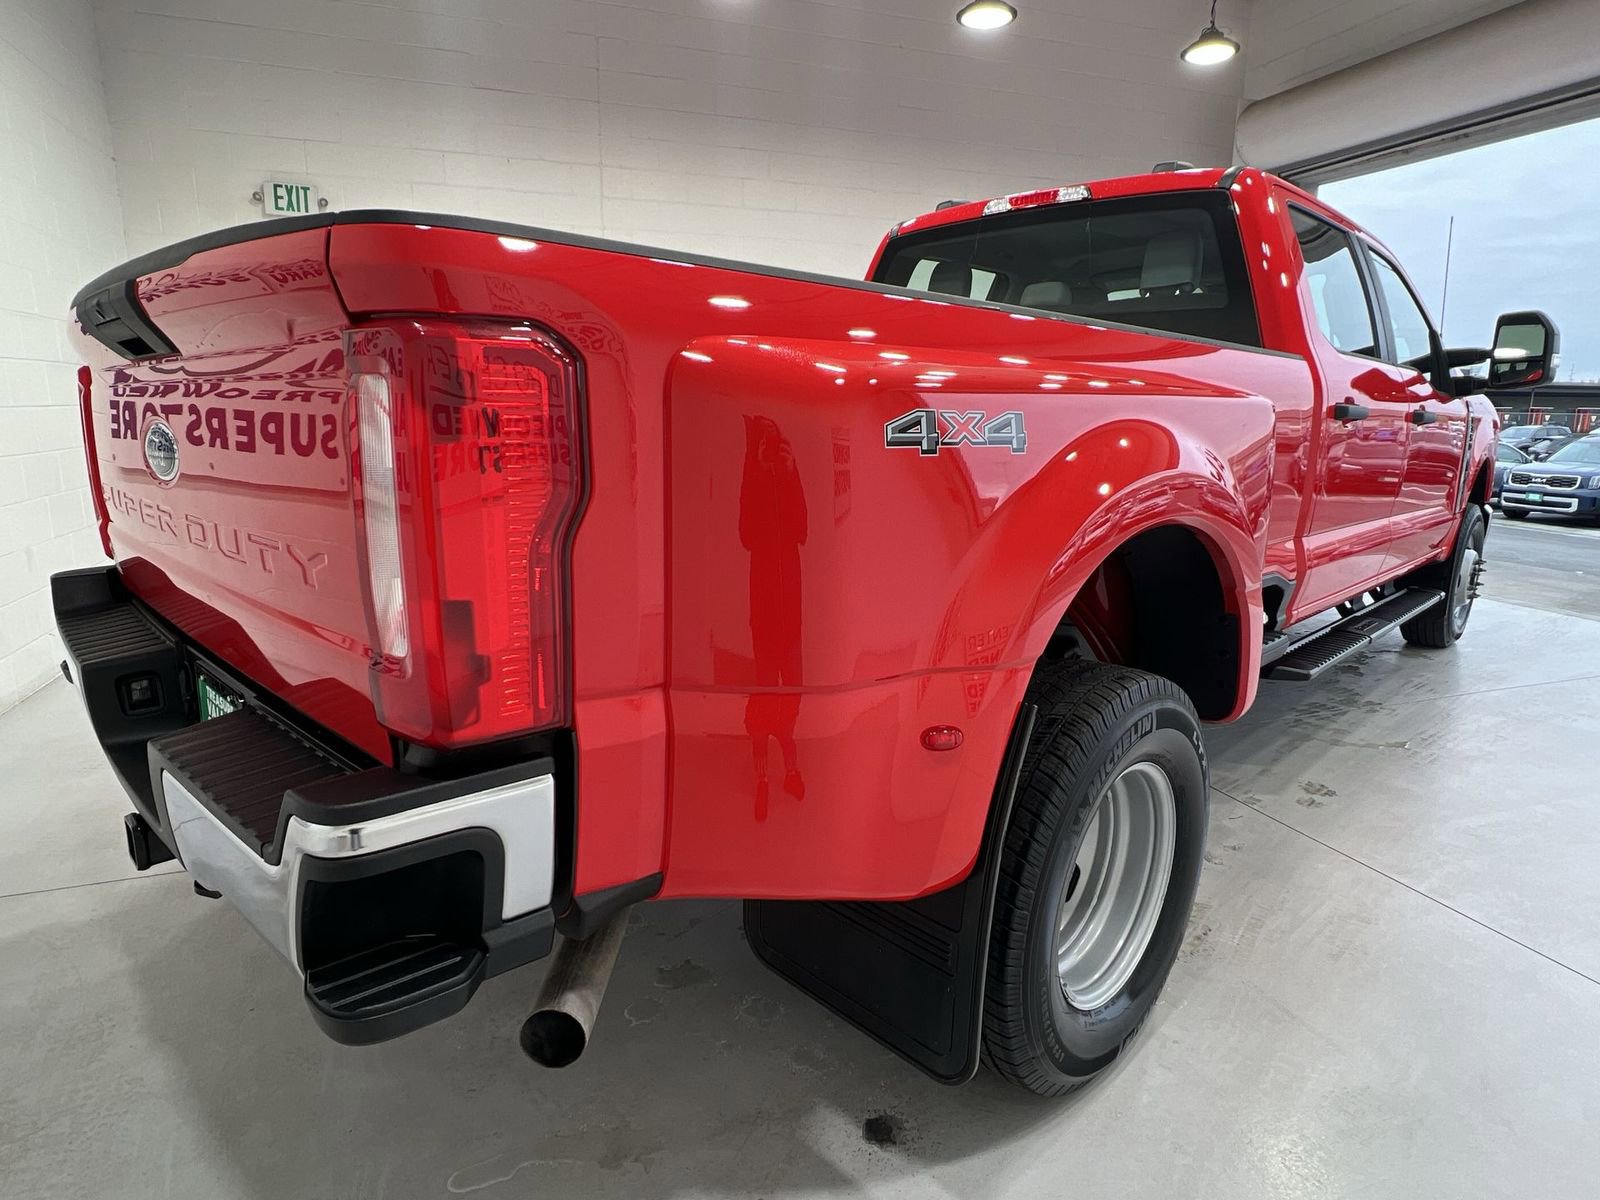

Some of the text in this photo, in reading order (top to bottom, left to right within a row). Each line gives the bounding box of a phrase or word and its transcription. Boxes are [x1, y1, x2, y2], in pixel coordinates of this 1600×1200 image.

[272, 182, 311, 214] EXIT
[185, 512, 328, 591] DUTY
[1087, 711, 1153, 803] MICHELIN
